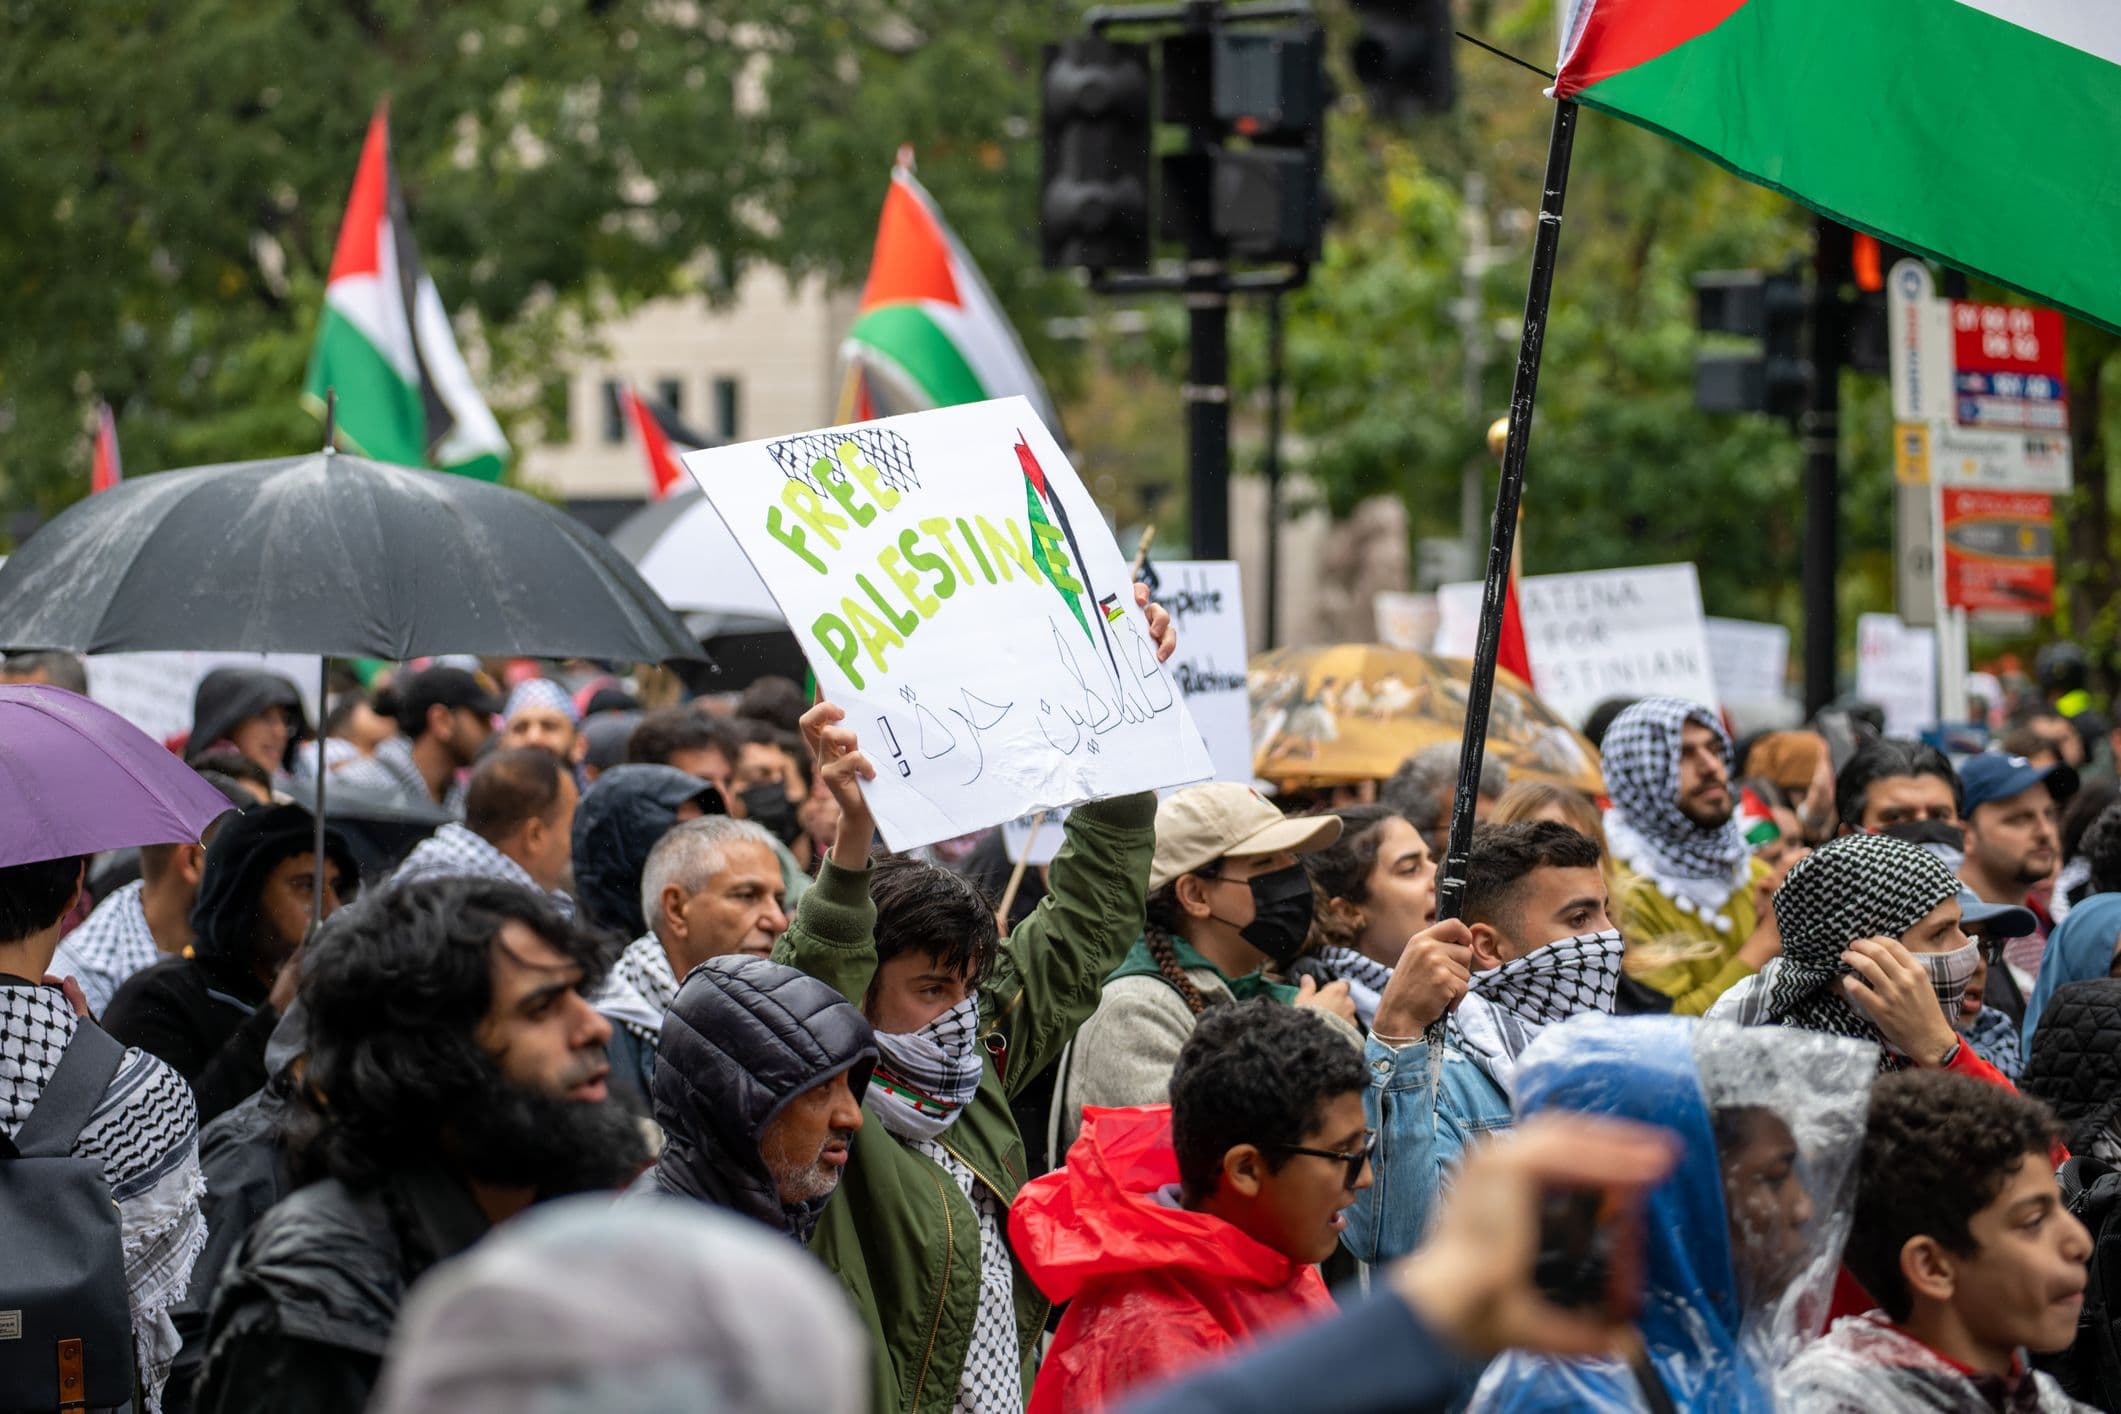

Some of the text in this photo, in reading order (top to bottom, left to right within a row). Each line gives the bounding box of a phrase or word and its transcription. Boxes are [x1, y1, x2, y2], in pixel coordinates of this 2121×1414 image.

[766, 440, 901, 575] FREE
[811, 514, 1083, 691] PALESTINE
[1543, 617, 1610, 650] FOR
[1035, 615, 1173, 756] فلسطين
[1544, 647, 1700, 694] STINIAN
